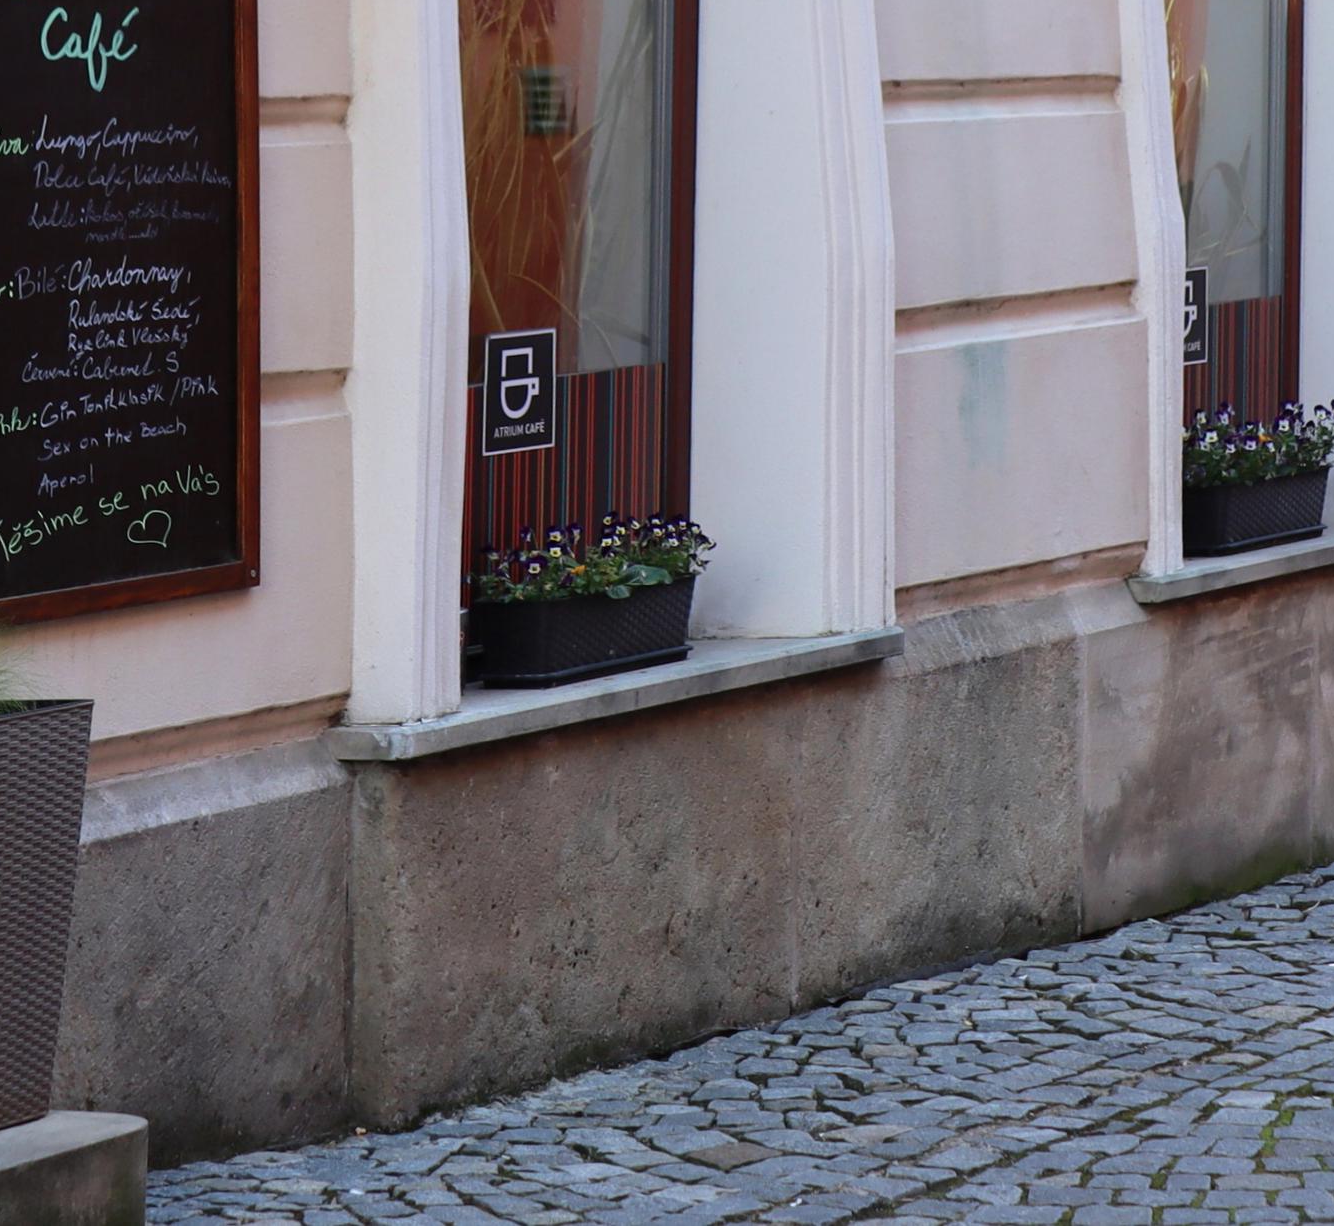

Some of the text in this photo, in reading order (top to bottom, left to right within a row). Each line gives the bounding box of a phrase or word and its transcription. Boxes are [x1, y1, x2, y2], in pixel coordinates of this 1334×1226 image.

[41, 7, 139, 93] Café
[40, 401, 78, 428] Gin
[494, 417, 545, 439] ATRIUM CAFÉ
[37, 415, 187, 461] Sex on the Beach
[37, 462, 94, 498] Aperol
[98, 491, 130, 516] se
[141, 479, 173, 501] na
[175, 464, 220, 496] Vás
